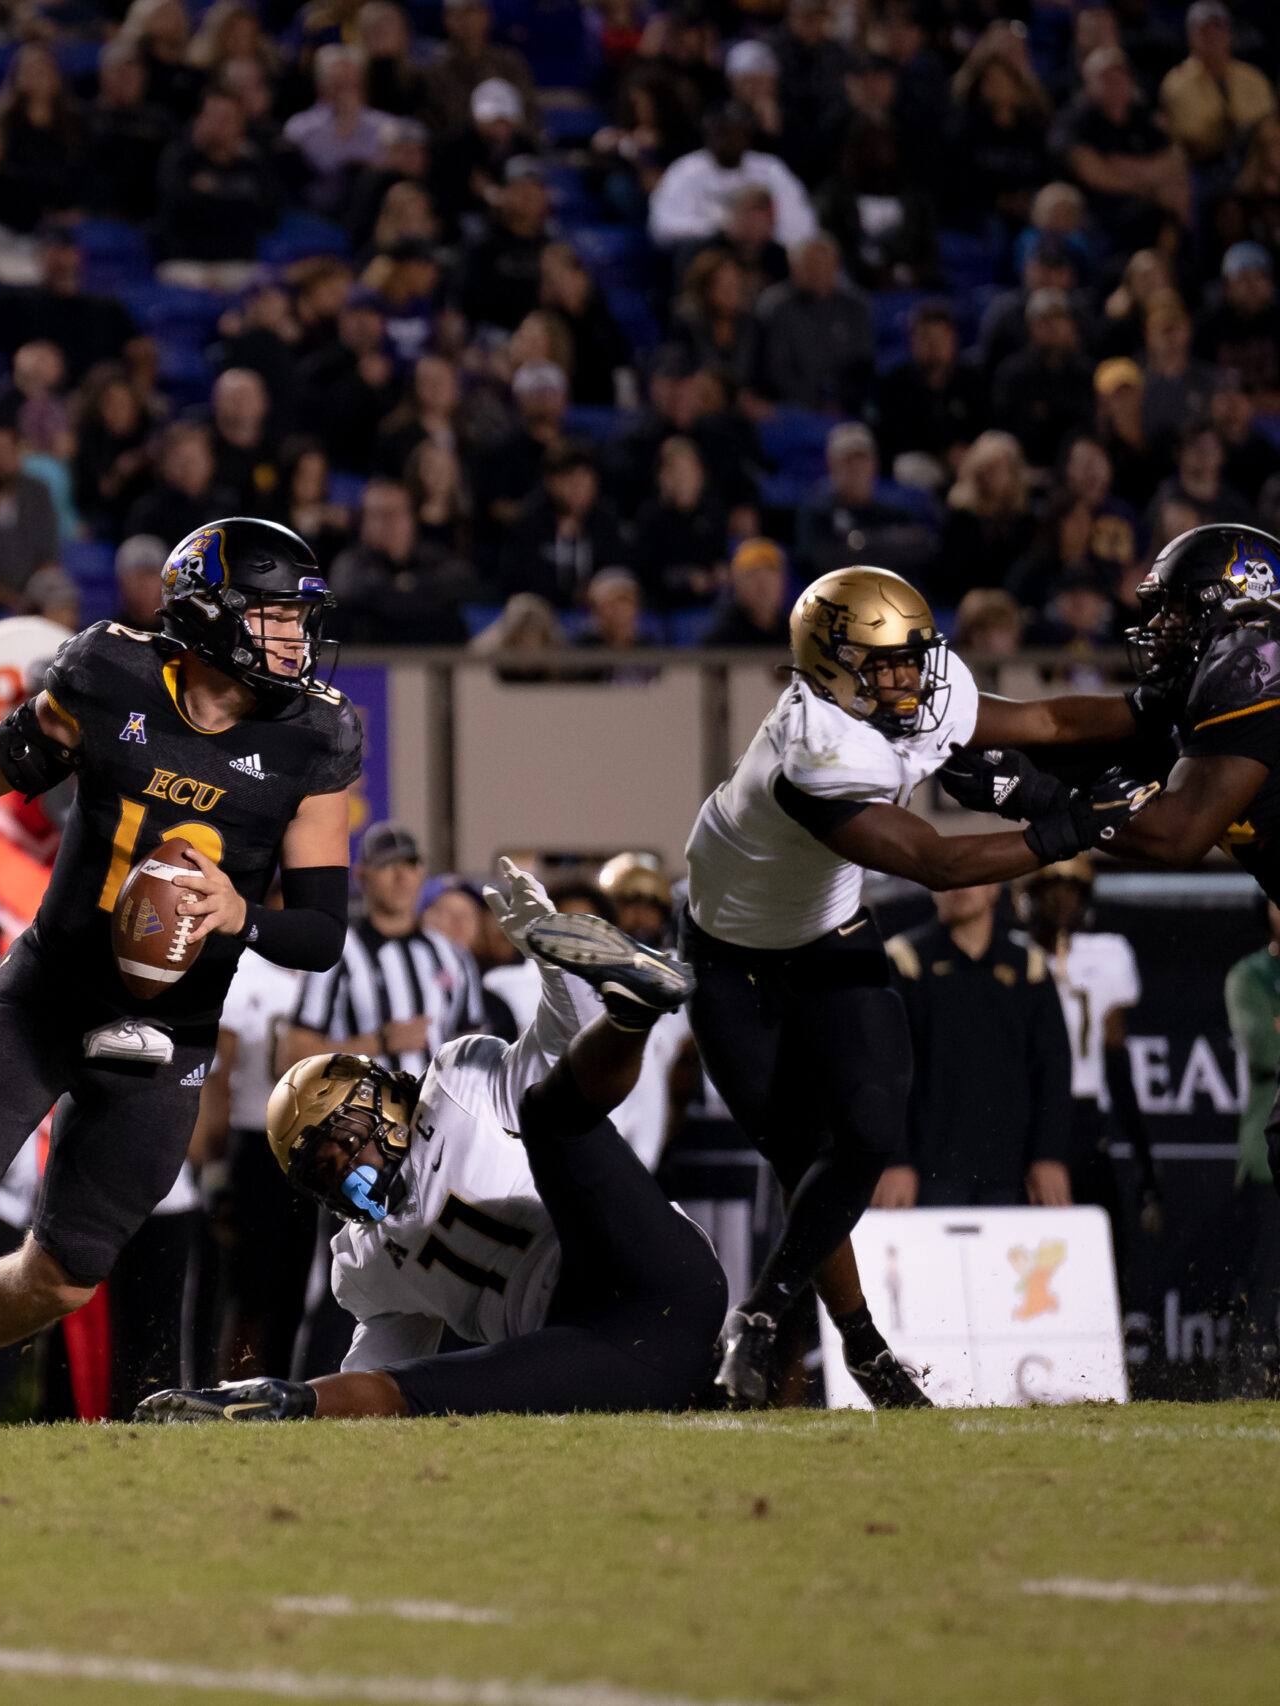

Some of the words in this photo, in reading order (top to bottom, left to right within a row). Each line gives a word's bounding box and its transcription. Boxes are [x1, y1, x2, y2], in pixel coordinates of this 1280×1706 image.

[229, 759, 266, 781] adidas
[142, 768, 227, 812] ECU
[995, 776, 1020, 806] adidas
